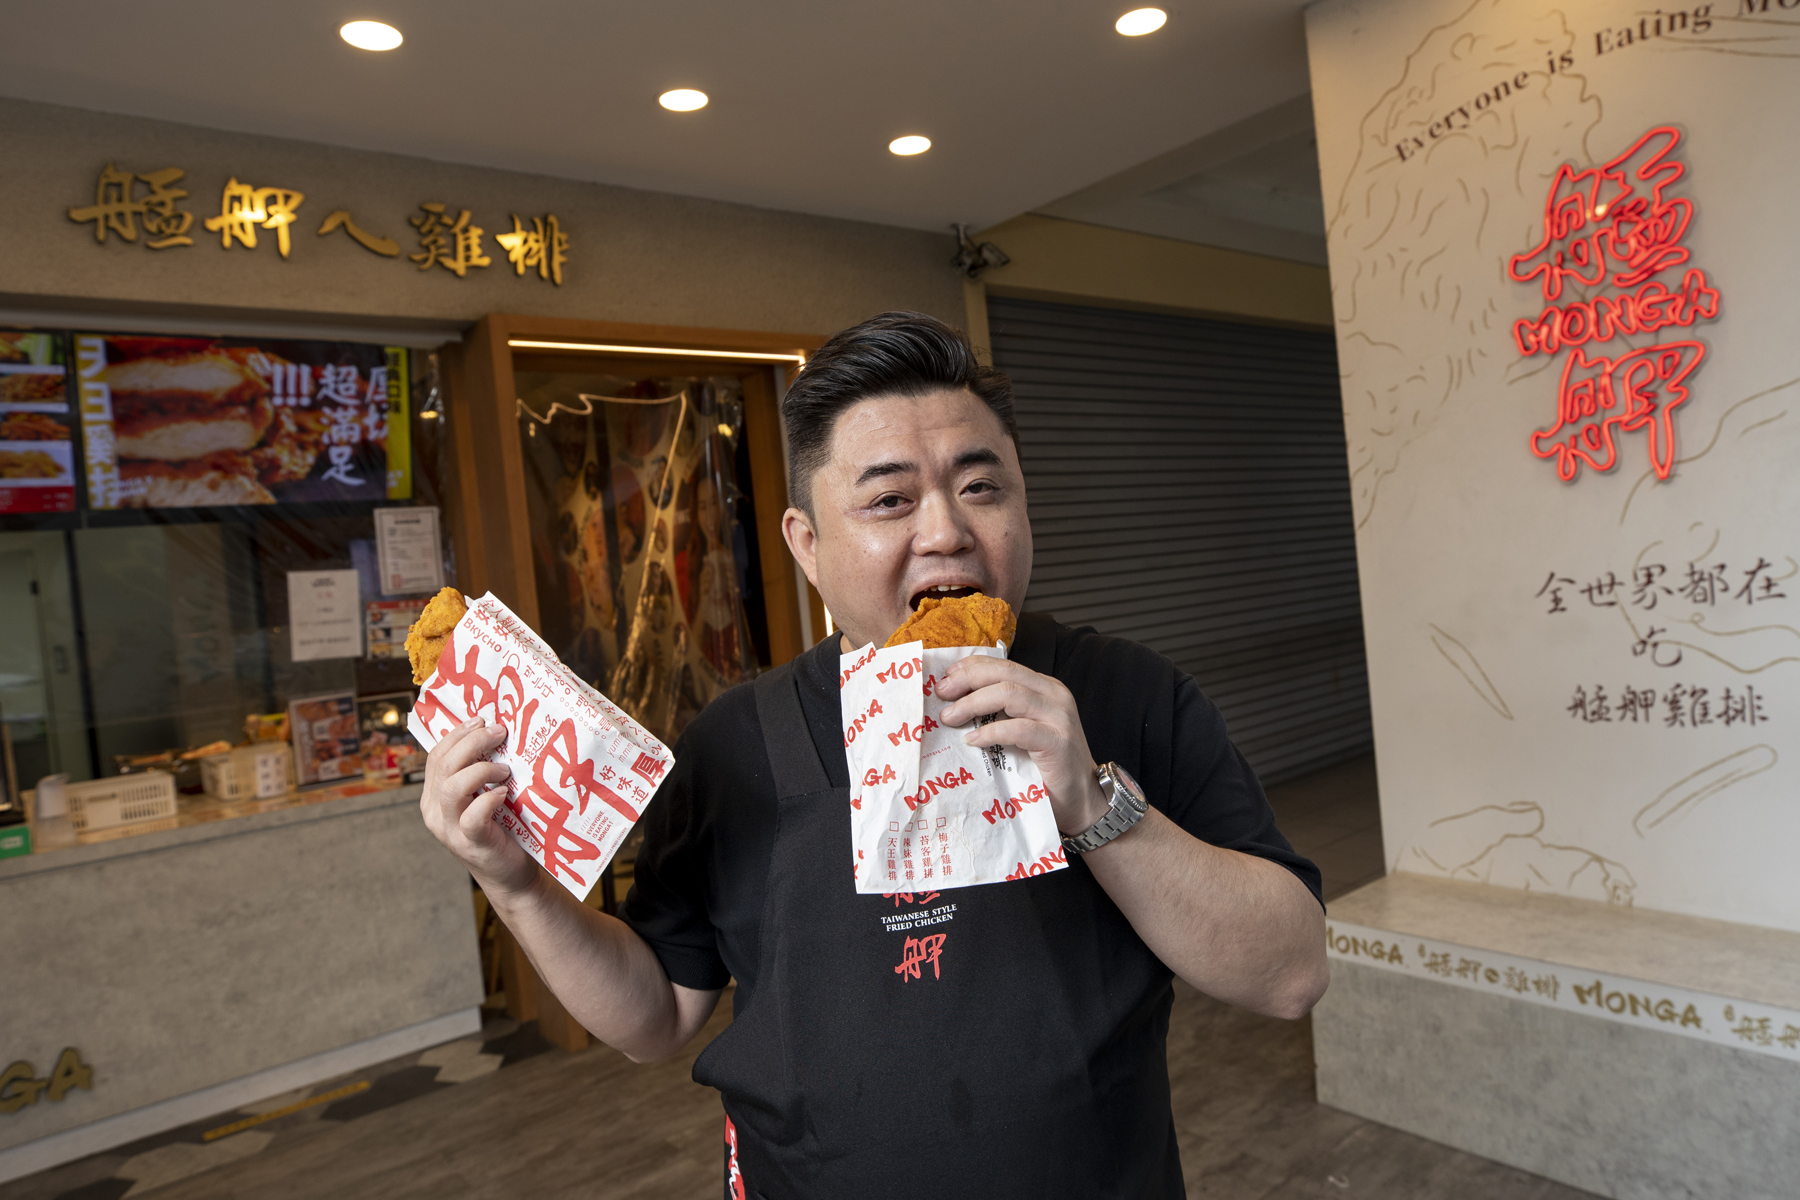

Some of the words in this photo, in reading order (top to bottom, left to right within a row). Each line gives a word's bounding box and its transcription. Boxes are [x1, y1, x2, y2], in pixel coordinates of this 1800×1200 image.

[1395, 71, 1529, 163] Everyone
[1547, 50, 1574, 75] is
[1594, 3, 1715, 56] Eating
[1513, 269, 1720, 356] MONGA
[317, 363, 366, 487] 超滿足
[1534, 557, 1788, 614] 全世界都在
[463, 618, 502, 653] Вкусно
[1631, 625, 1683, 668] 吃
[1566, 682, 1770, 728] 艋舺雞排
[598, 764, 649, 805] 好味道
[586, 810, 605, 835] EVERYONE
[594, 816, 609, 834] EATING
[887, 837, 898, 881] 天王雞排
[920, 835, 933, 879] 苔客雞排
[938, 832, 953, 876] 梅子雞排
[880, 910, 930, 925] TAIWANESE
[931, 903, 957, 916] STYLE
[885, 921, 913, 932] FRIED
[914, 912, 953, 928] CHICKEN
